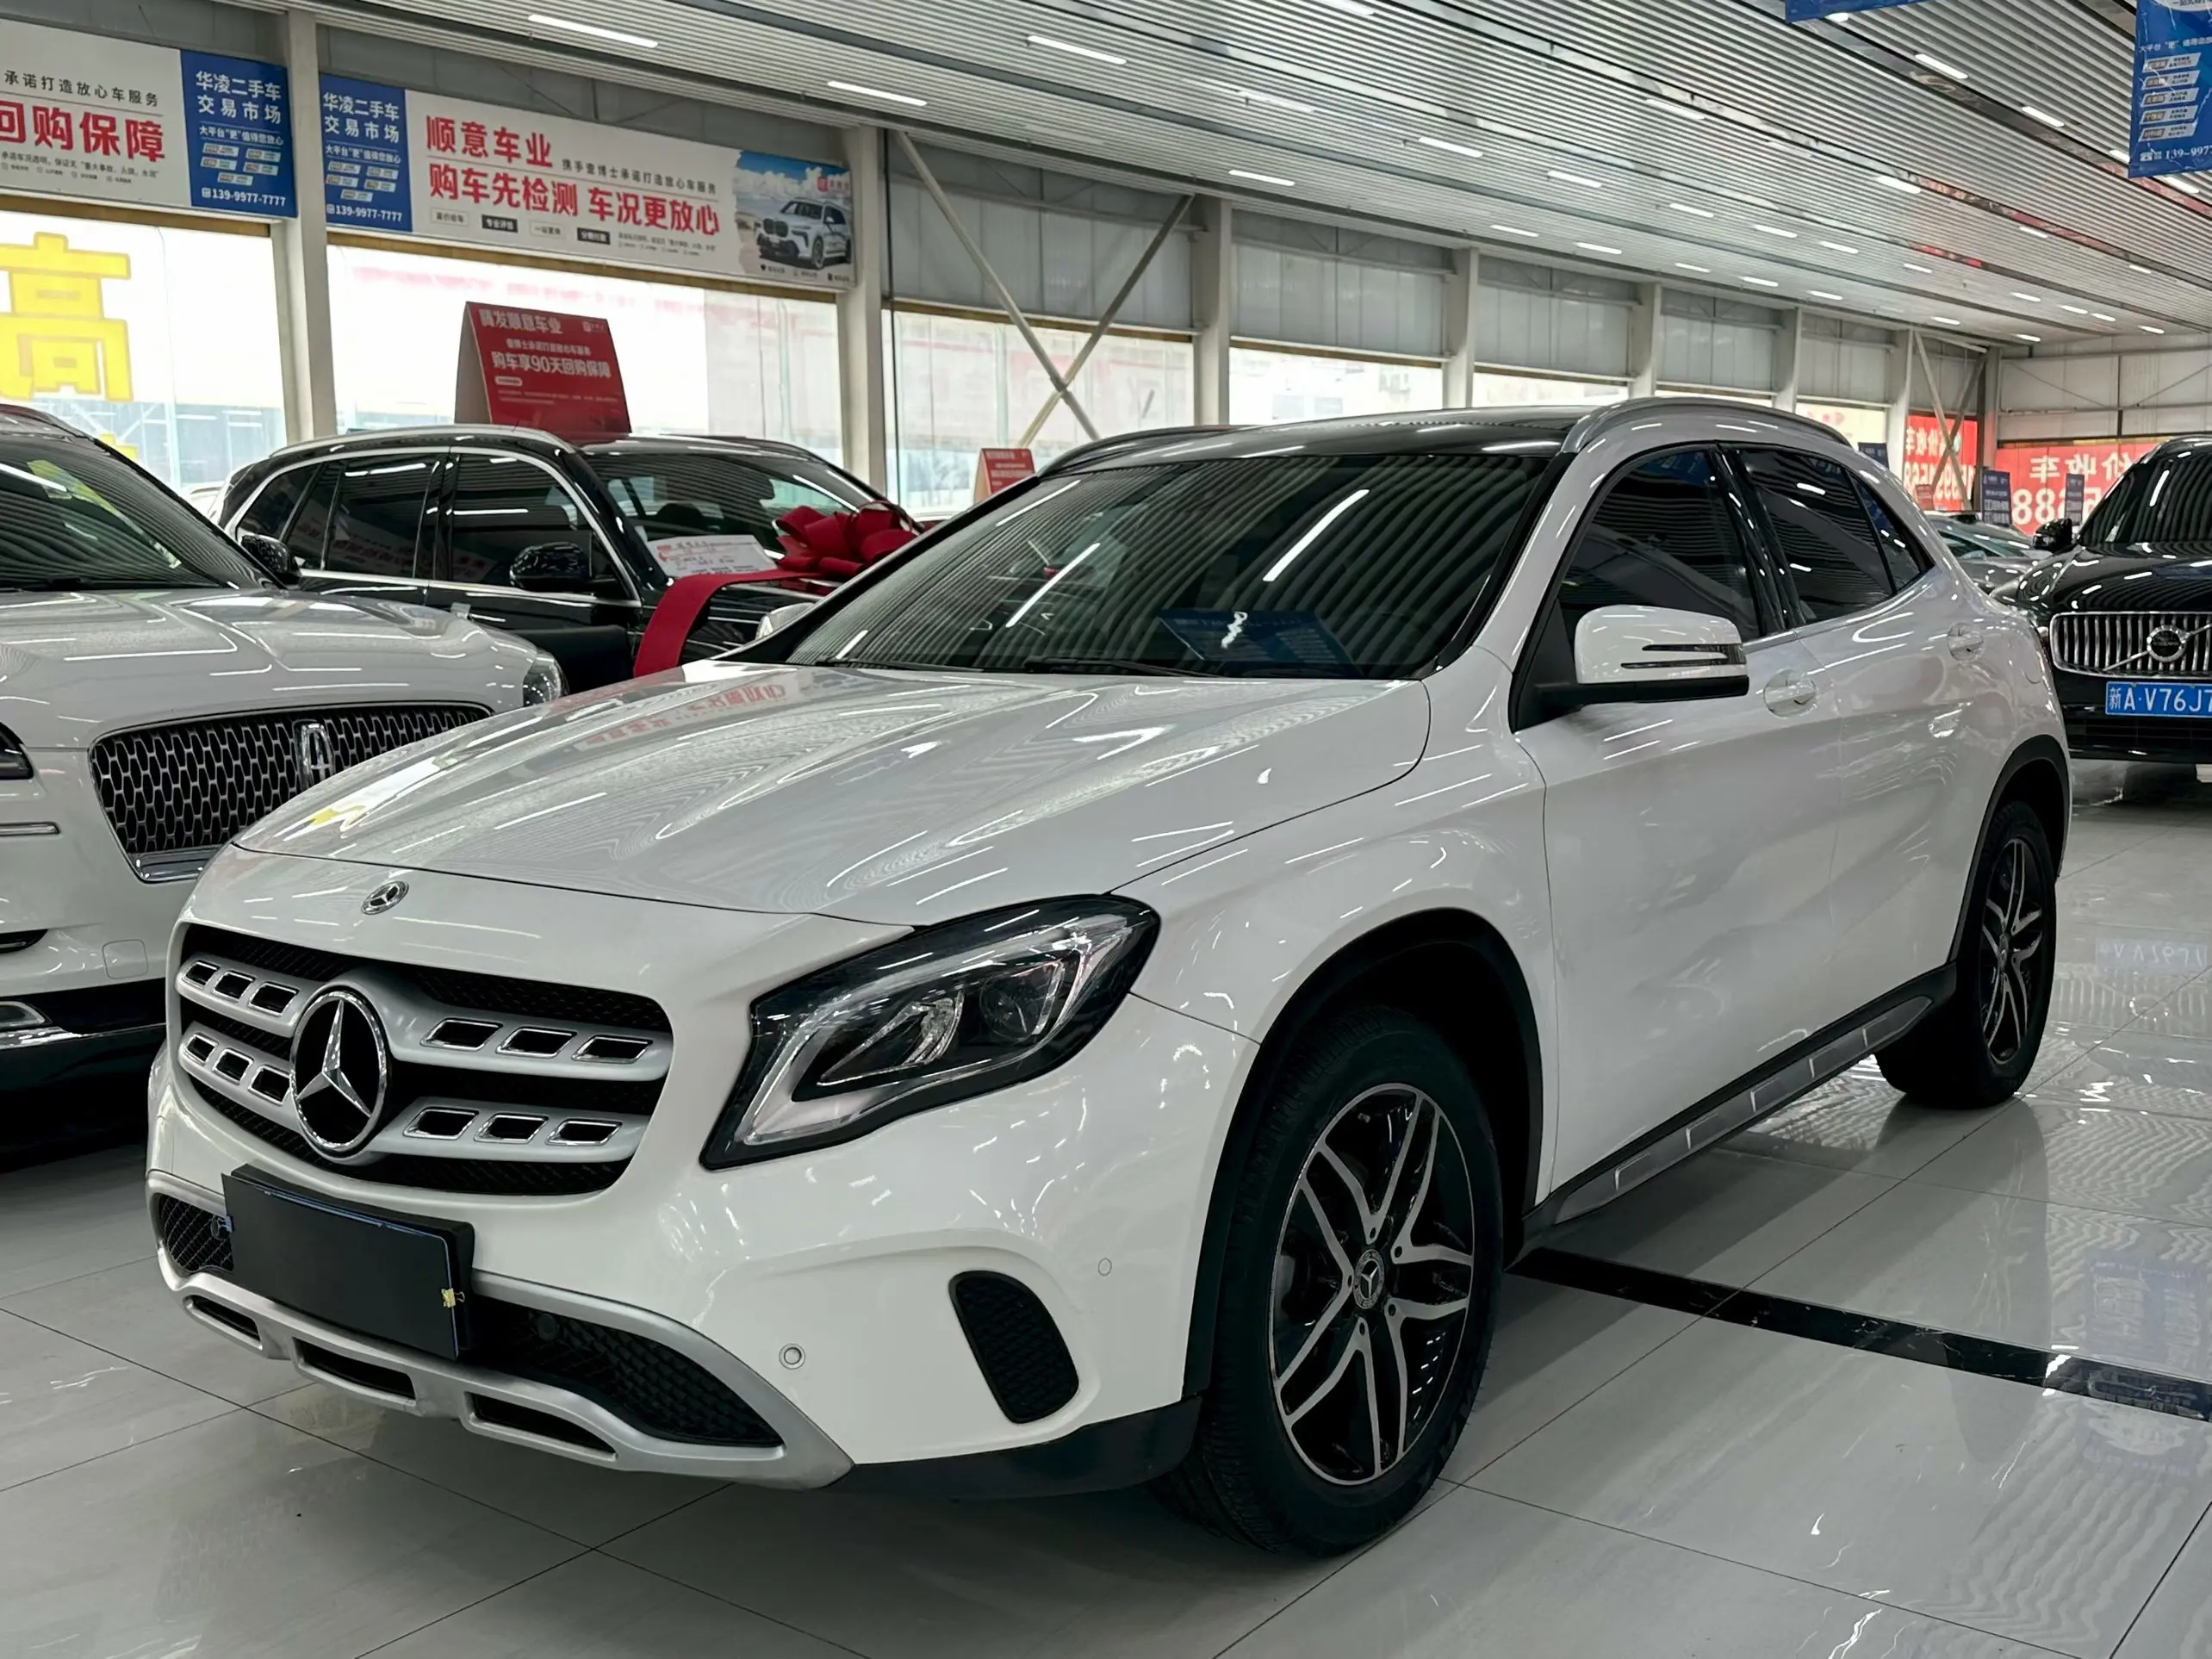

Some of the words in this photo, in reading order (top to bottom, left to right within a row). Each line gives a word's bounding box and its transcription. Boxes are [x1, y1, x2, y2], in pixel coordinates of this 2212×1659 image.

[4, 70, 159, 107] 承诺打造放心车服务
[196, 71, 281, 101] 华凌二手车
[197, 95, 282, 125] 交易市场
[323, 92, 400, 121] 华凌二手车
[0, 101, 165, 163] 回购保障
[324, 115, 399, 144] 交易市场
[426, 115, 553, 168] 顺意车业
[2166, 145, 2212, 160] 139-997
[212, 188, 286, 206] 139-9977-7777
[429, 163, 578, 216] 购车先检测
[588, 187, 720, 236] 车况更放心
[335, 205, 402, 222] 139-9977-7777
[0, 231, 134, 402] 高
[491, 351, 612, 379] 购车享90天回购保障
